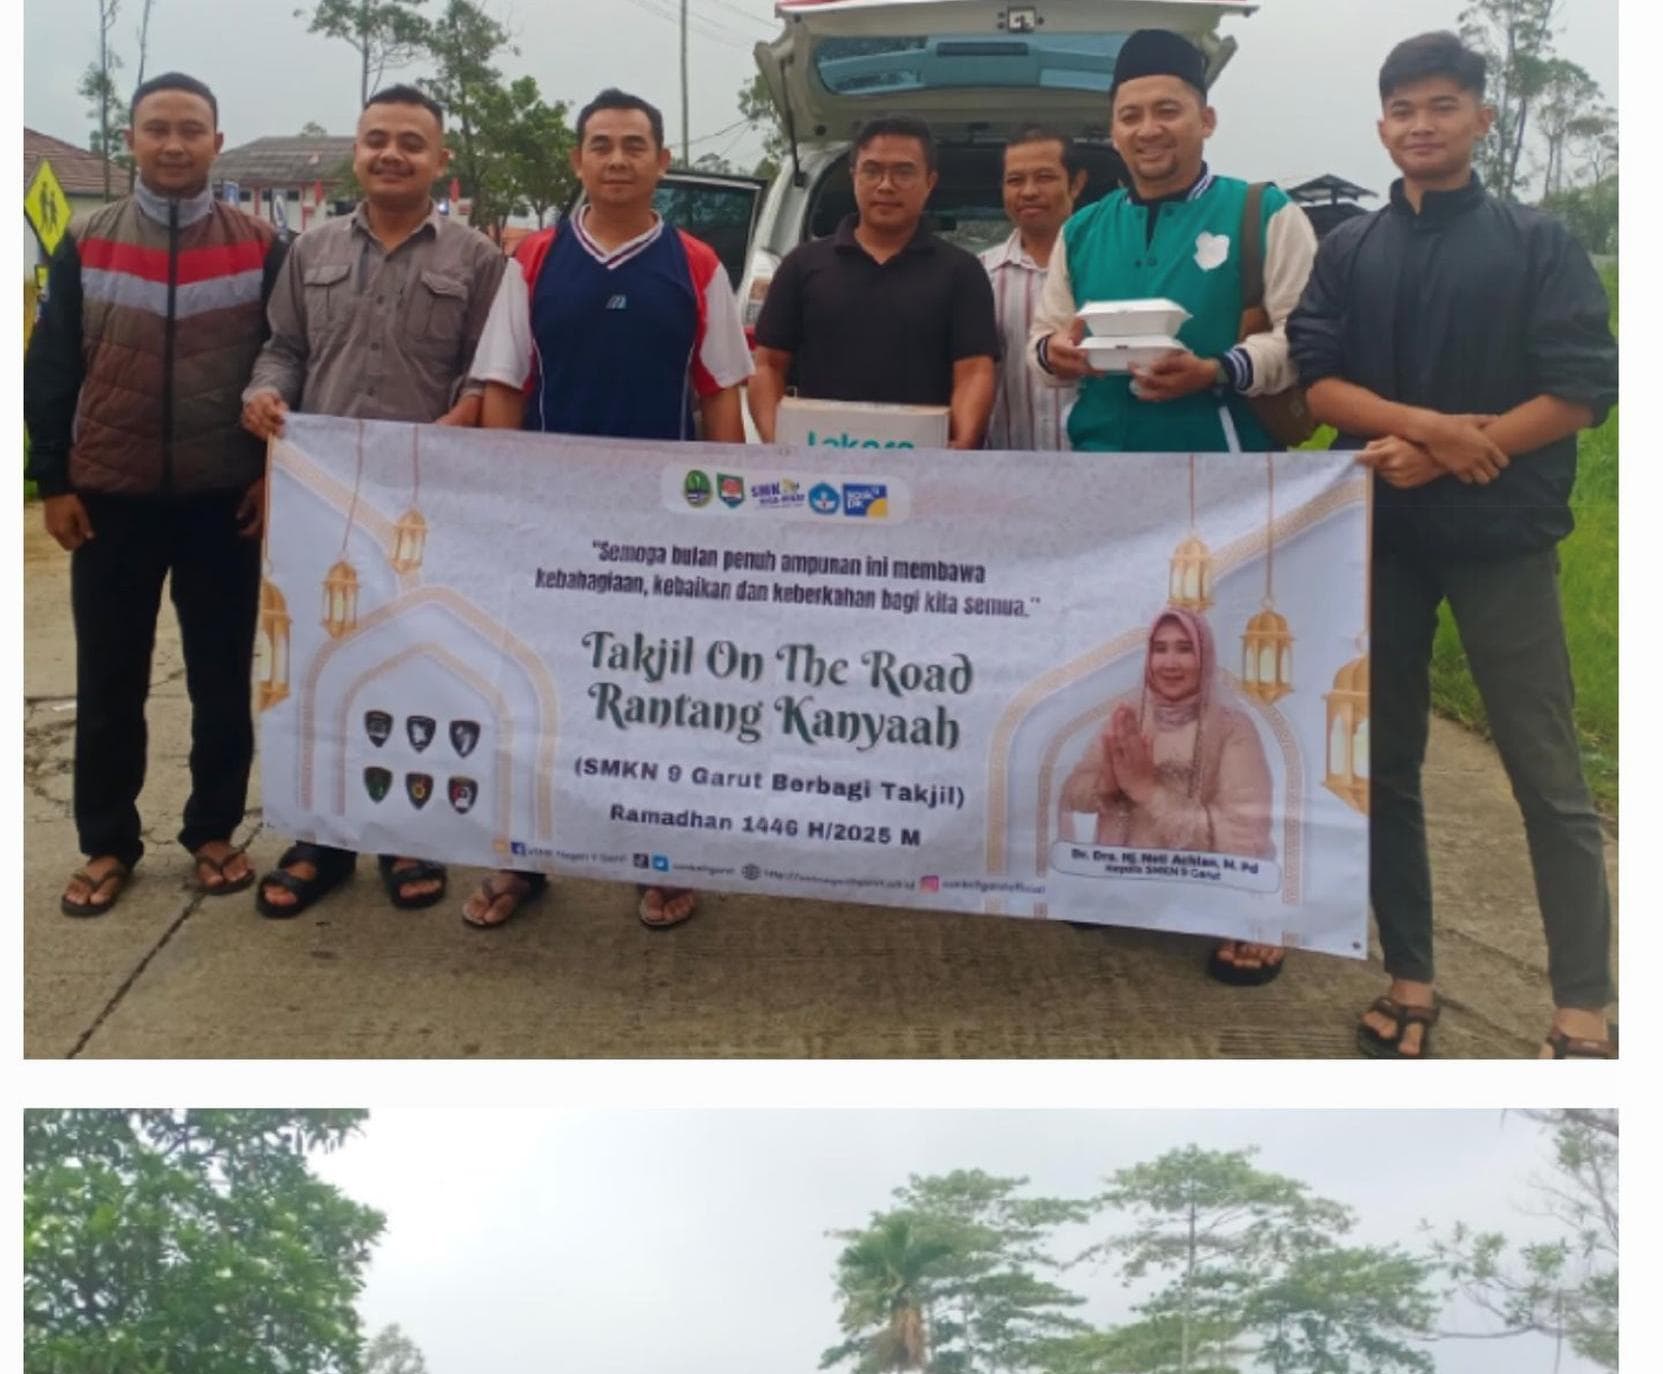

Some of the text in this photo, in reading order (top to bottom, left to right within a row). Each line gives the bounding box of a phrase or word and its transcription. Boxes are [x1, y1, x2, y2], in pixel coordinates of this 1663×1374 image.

[592, 539, 986, 583] "Semoga bulan penuh ampunan ini membawa
[535, 568, 1040, 618] kebahagiaan, kebaikan dan keberkahan bagi kita semua."
[582, 631, 974, 698] Takjil On The Road
[588, 682, 960, 752] Rantang Kanyaah
[574, 757, 965, 810] (SMKN 9 Garut Berbagi Takjil)
[610, 803, 922, 846] Ramadhan 1446 H/2025 M
